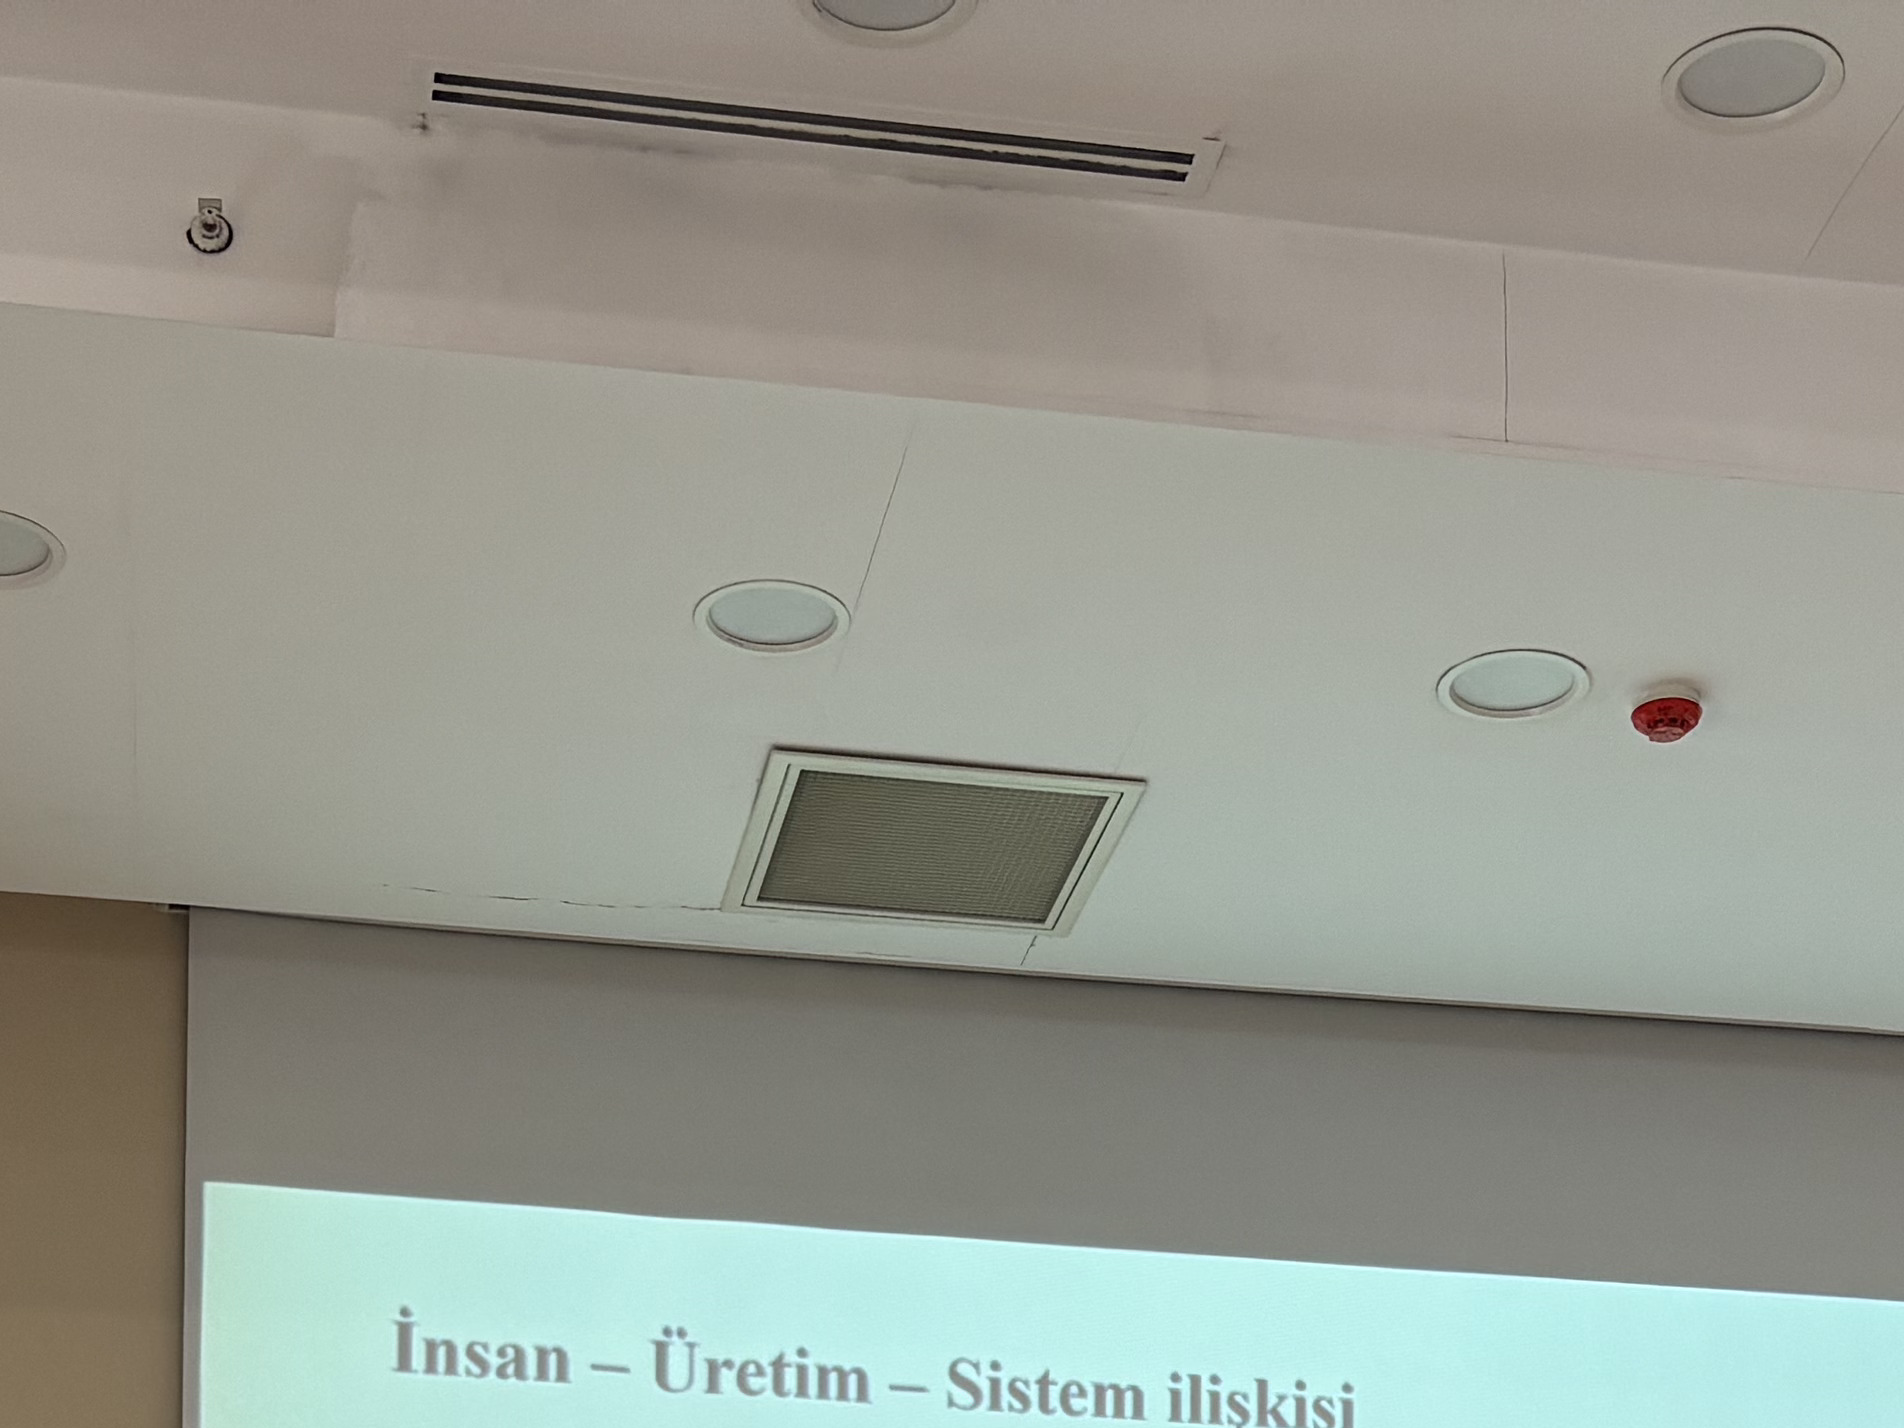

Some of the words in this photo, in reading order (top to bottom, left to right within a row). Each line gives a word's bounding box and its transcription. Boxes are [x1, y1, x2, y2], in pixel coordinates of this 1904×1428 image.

[391, 1305, 571, 1383] İnsan
[650, 1324, 872, 1404] Üretim
[946, 1357, 1147, 1421] Sistem
